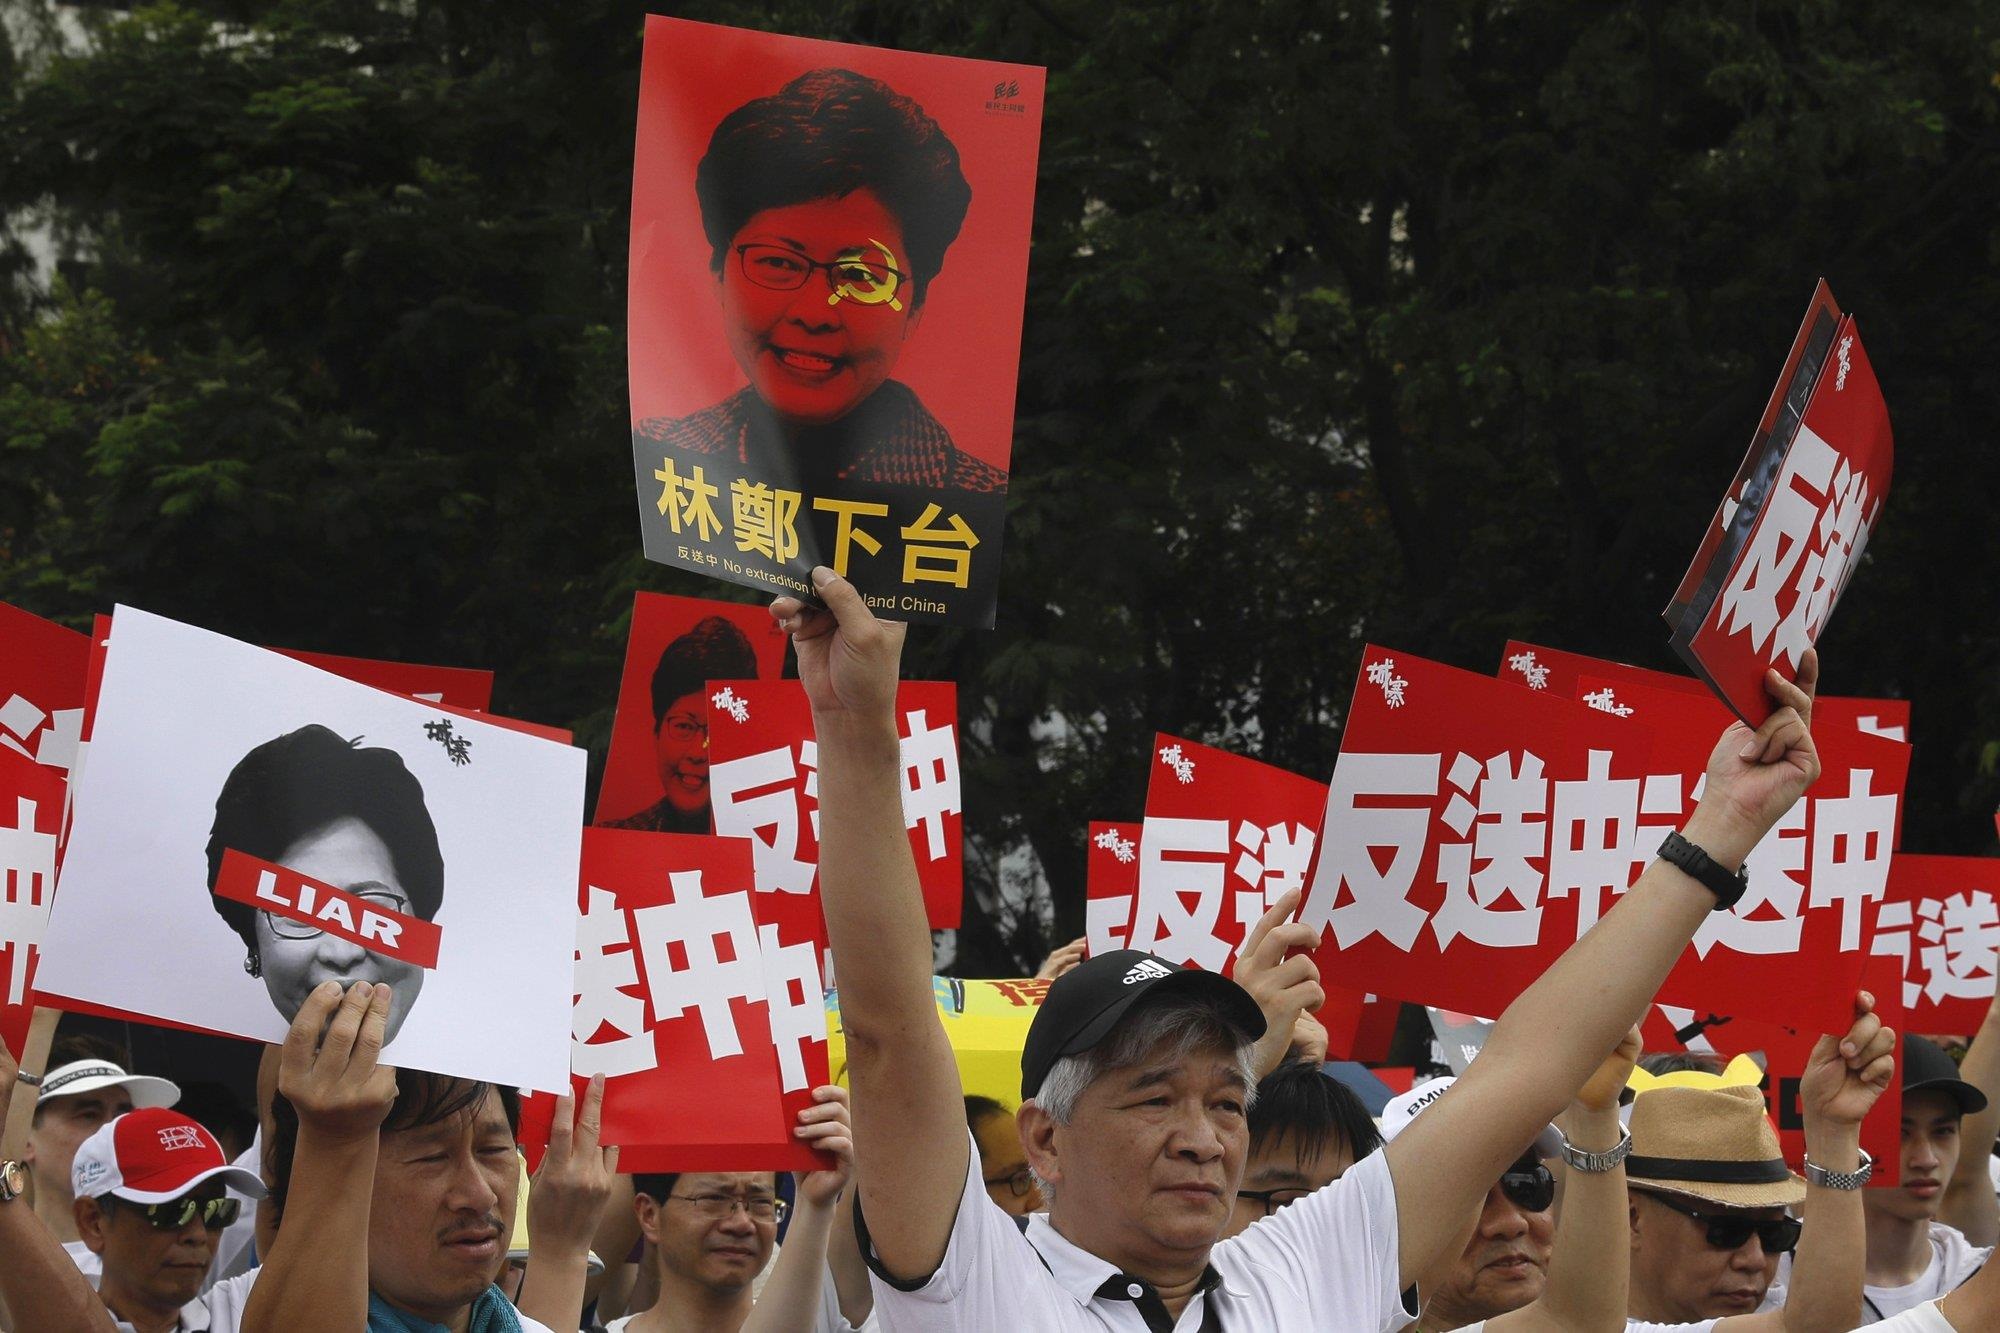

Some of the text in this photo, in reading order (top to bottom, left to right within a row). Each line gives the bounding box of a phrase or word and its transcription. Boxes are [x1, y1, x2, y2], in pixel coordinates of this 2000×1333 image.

[653, 457, 981, 589] 林鄭下台
[677, 545, 718, 568] 反送中
[723, 558, 742, 574] No
[745, 567, 809, 594] extradition
[901, 596, 947, 614] China
[711, 686, 750, 724] 城寨
[1365, 658, 1409, 709] 城寨
[423, 718, 472, 767] 城寨
[1158, 744, 1196, 785] 城寨
[1094, 828, 1136, 865] 城寨
[1300, 748, 1641, 954] 反送中
[256, 869, 403, 949] LIAR
